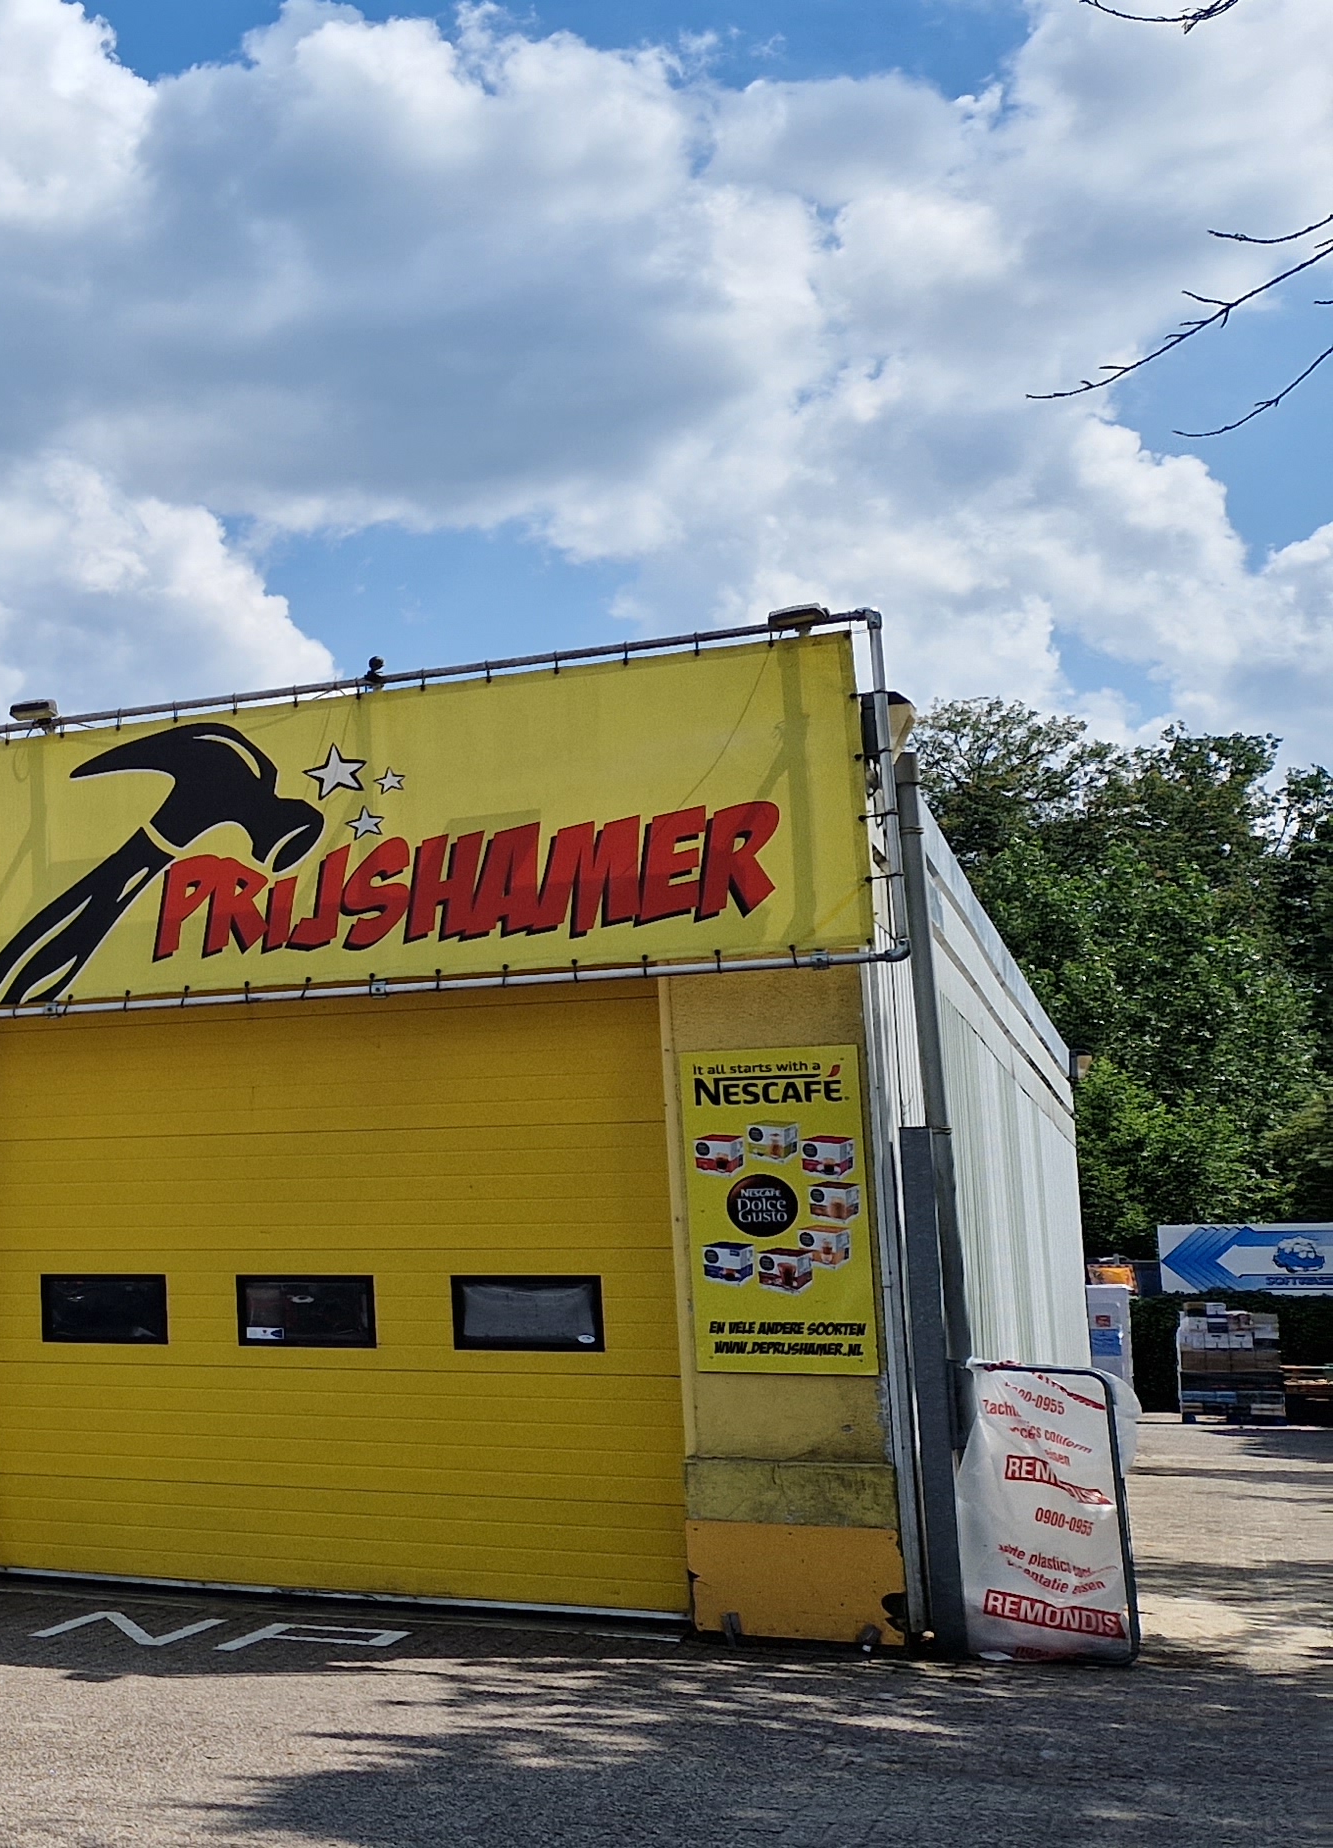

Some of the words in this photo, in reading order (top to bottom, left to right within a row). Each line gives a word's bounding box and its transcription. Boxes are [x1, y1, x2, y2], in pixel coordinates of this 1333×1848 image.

[152, 801, 780, 963] PRIJSHAMER
[693, 1064, 703, 1075] It
[707, 1064, 726, 1075] all
[729, 1063, 772, 1074] starts
[780, 1061, 808, 1072] with
[811, 1062, 821, 1071] a
[694, 1066, 844, 1106] NESCAFÉ
[736, 1198, 787, 1212] Dolce
[738, 1209, 788, 1224] Gusto
[709, 1321, 725, 1334] EN
[728, 1321, 756, 1335] VELE
[757, 1321, 806, 1336] ANDERE
[807, 1321, 866, 1336] SOORTEN
[714, 1340, 863, 1357] WWW.DEPRIJSHAMER.NL
[1035, 1507, 1094, 1537] 0900-0955
[1072, 1580, 1106, 1595] eisen
[986, 1592, 1120, 1635] REMONDIS
